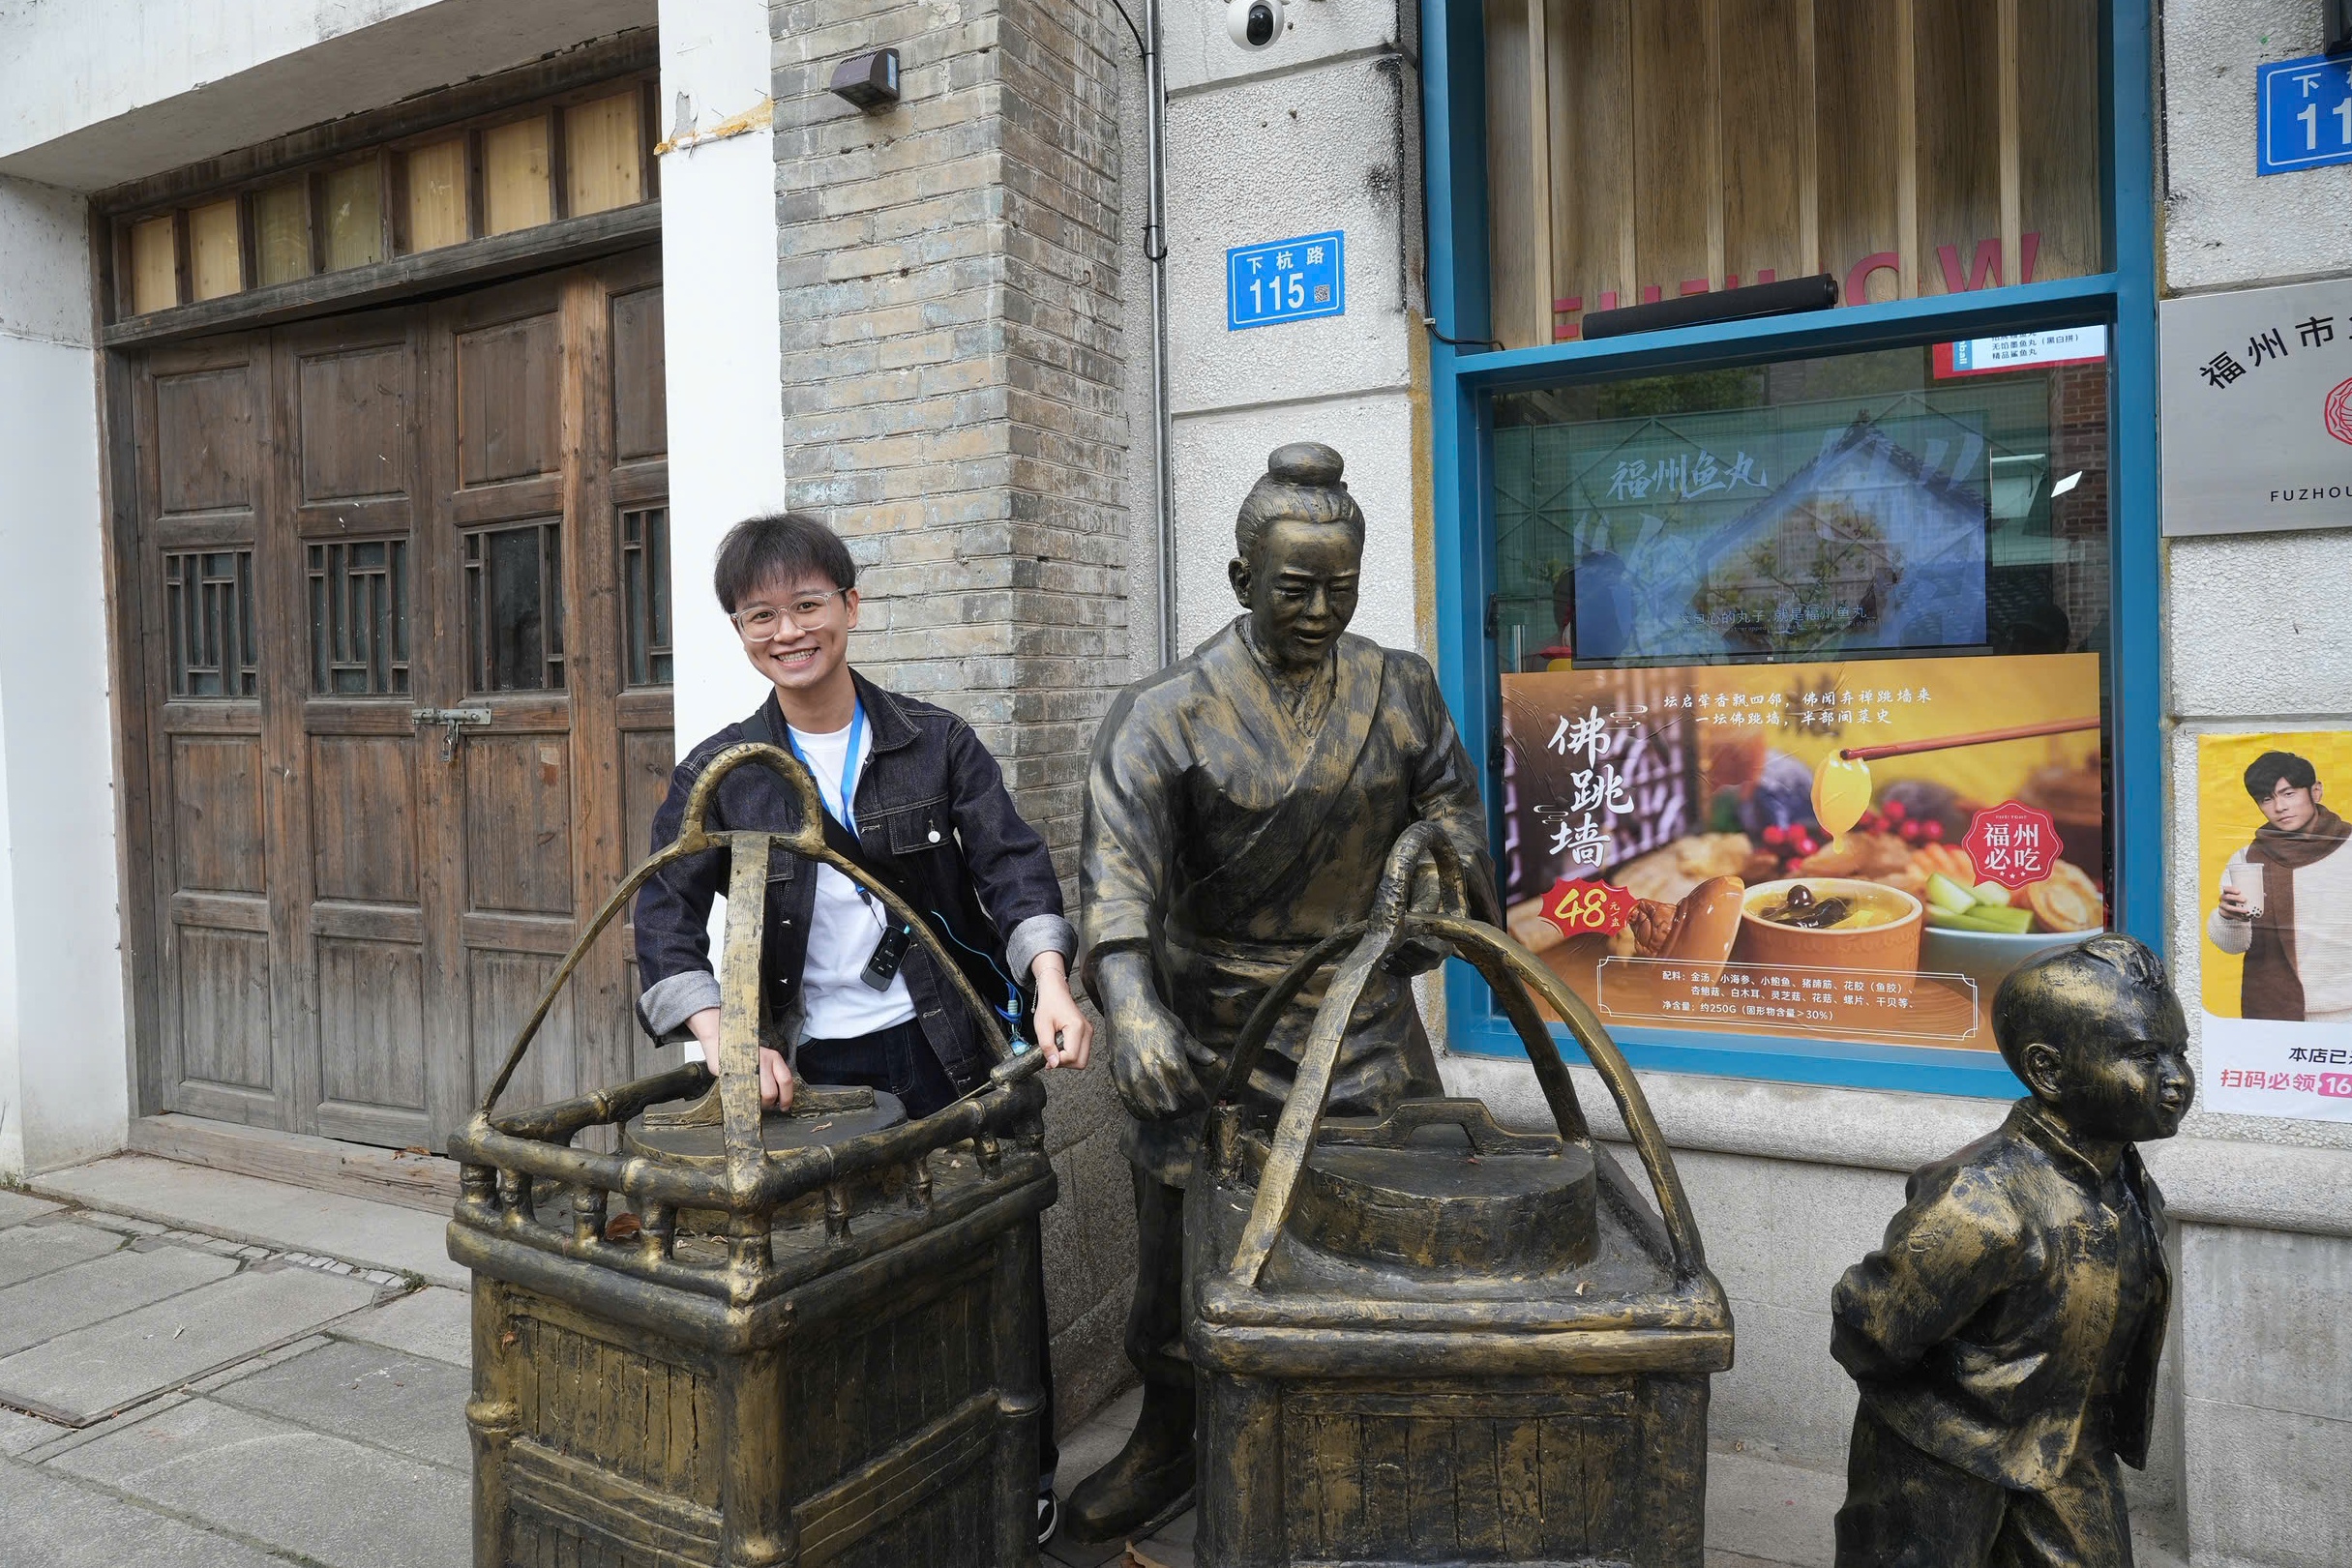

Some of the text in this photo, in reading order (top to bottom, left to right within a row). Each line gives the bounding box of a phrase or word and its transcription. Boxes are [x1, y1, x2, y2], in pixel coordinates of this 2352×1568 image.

[2297, 97, 2352, 151] 11
[1246, 246, 1325, 275] 下杭路
[1250, 272, 1305, 313] 115
[2199, 316, 2352, 390] 福州市
[1606, 450, 1768, 500] 福州鱼丸
[1548, 705, 1635, 868] 佛跳墙
[1982, 823, 2039, 847] 福州
[1984, 847, 2040, 871] 必吃
[1554, 888, 1607, 927] 48
[2288, 1048, 2352, 1064] 本店已
[2220, 1069, 2352, 1095] 扫码必领 16
